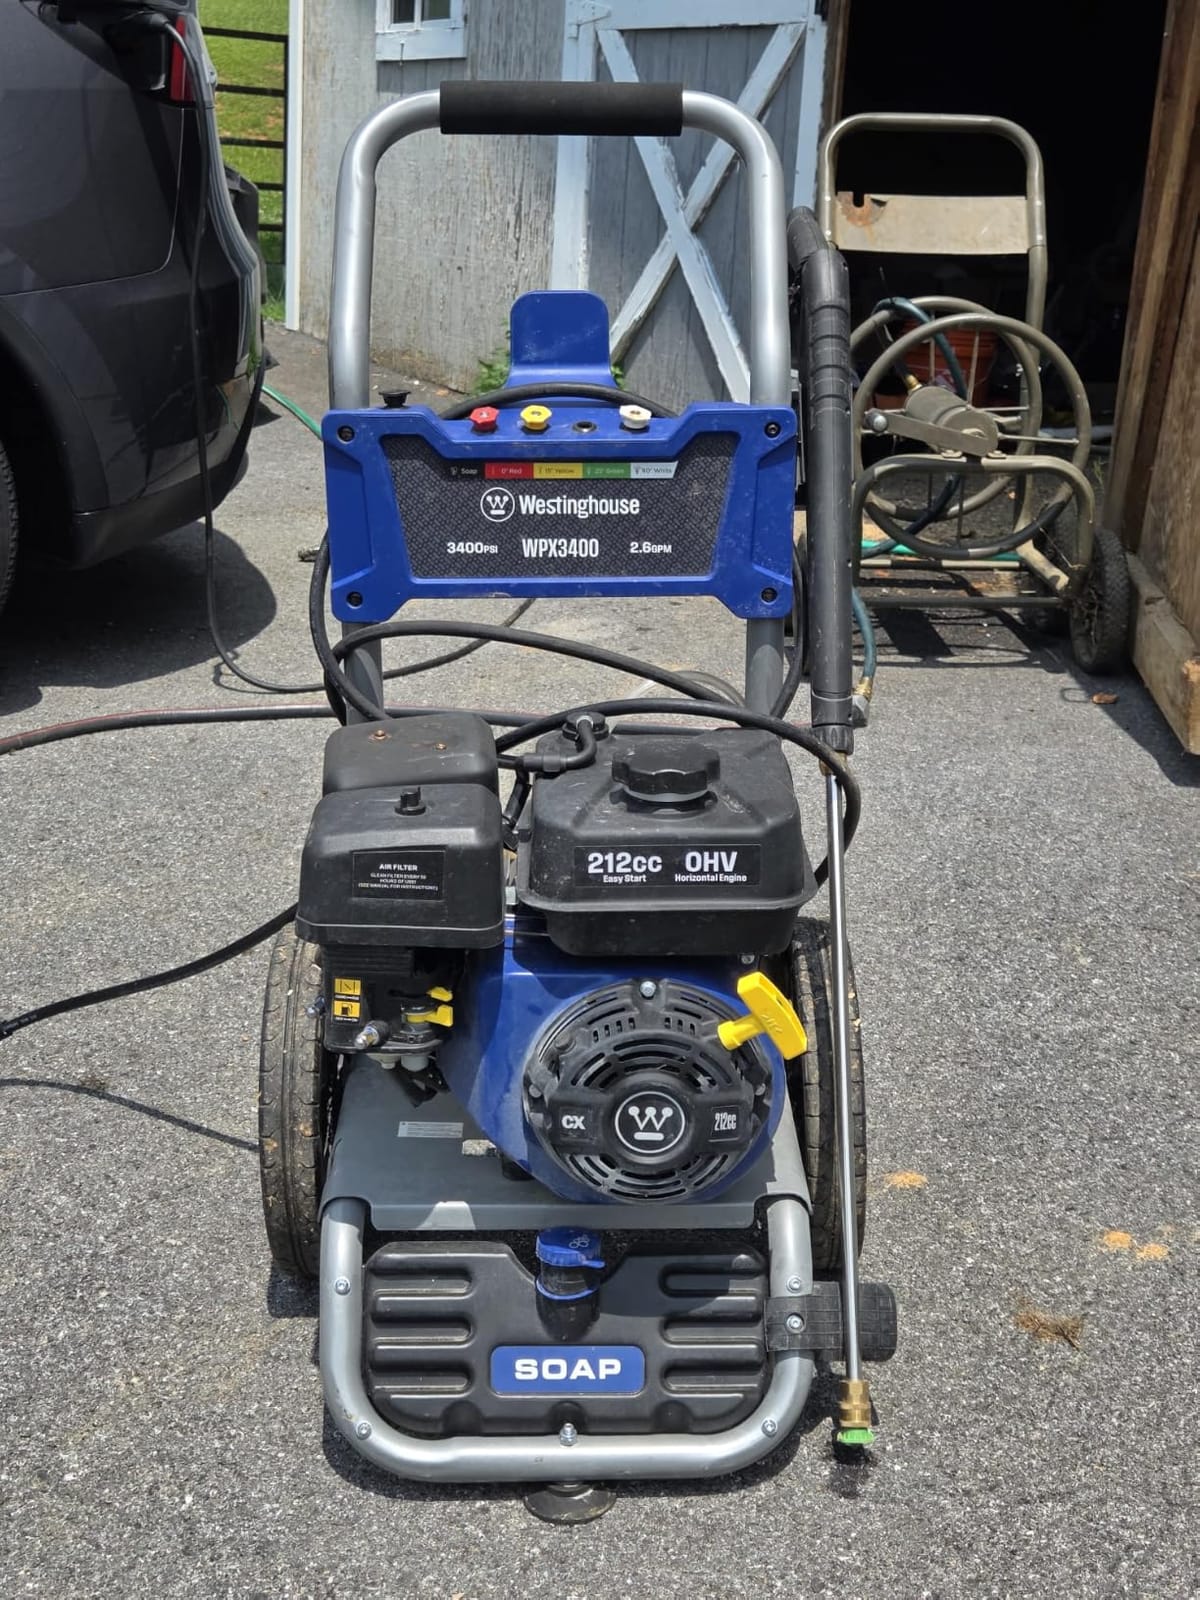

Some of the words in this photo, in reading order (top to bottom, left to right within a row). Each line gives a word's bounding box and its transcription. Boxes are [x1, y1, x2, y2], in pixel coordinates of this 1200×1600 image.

[519, 494, 640, 518] Westinghouse
[522, 538, 599, 558] WPX3400
[588, 852, 662, 874] 212cc
[685, 851, 738, 872] OHV
[603, 874, 623, 884] Easy
[624, 874, 646, 882] Start
[675, 874, 718, 882] Horizontal
[719, 874, 747, 883] Engine
[562, 1114, 586, 1130] CX
[514, 1358, 621, 1380] SOAP
